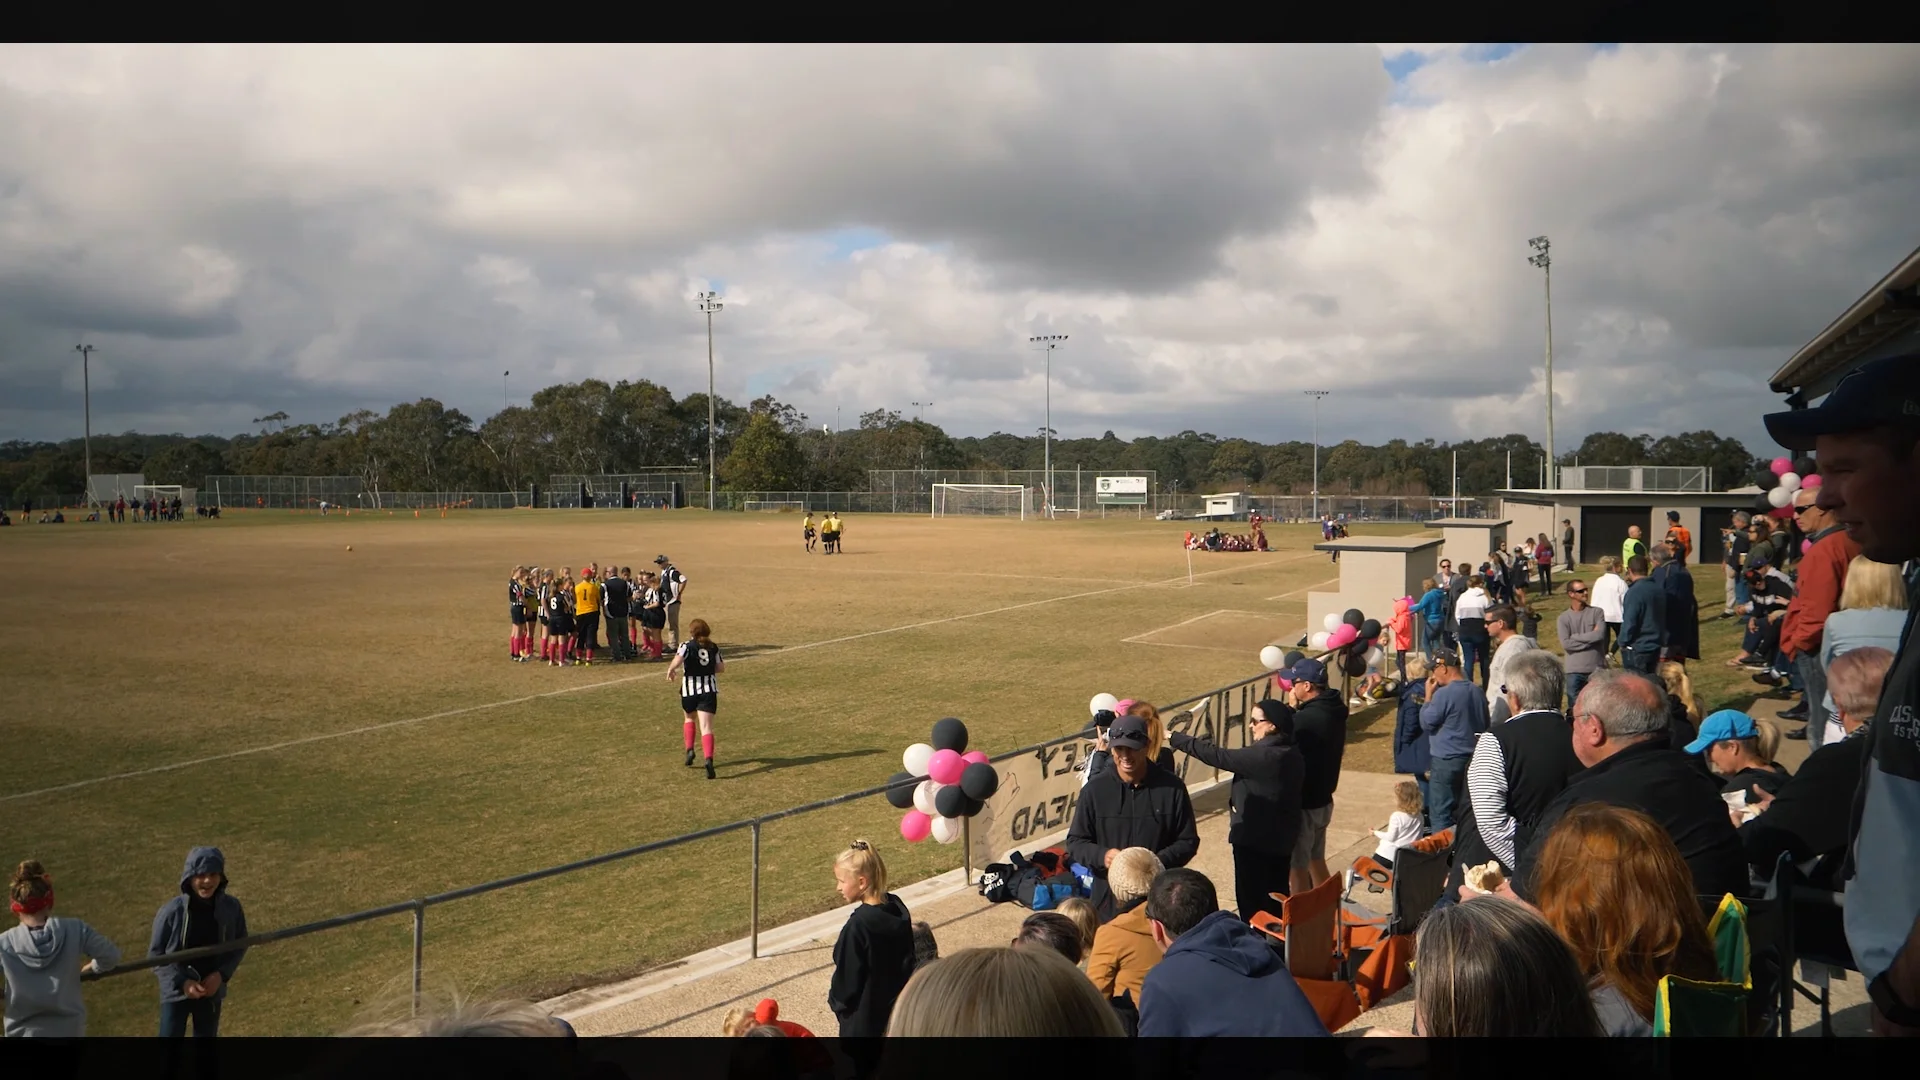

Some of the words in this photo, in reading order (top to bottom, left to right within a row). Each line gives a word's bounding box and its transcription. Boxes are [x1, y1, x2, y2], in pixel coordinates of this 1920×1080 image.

[583, 589, 588, 601] 1
[550, 596, 557, 610] 6
[698, 648, 709, 666] 9
